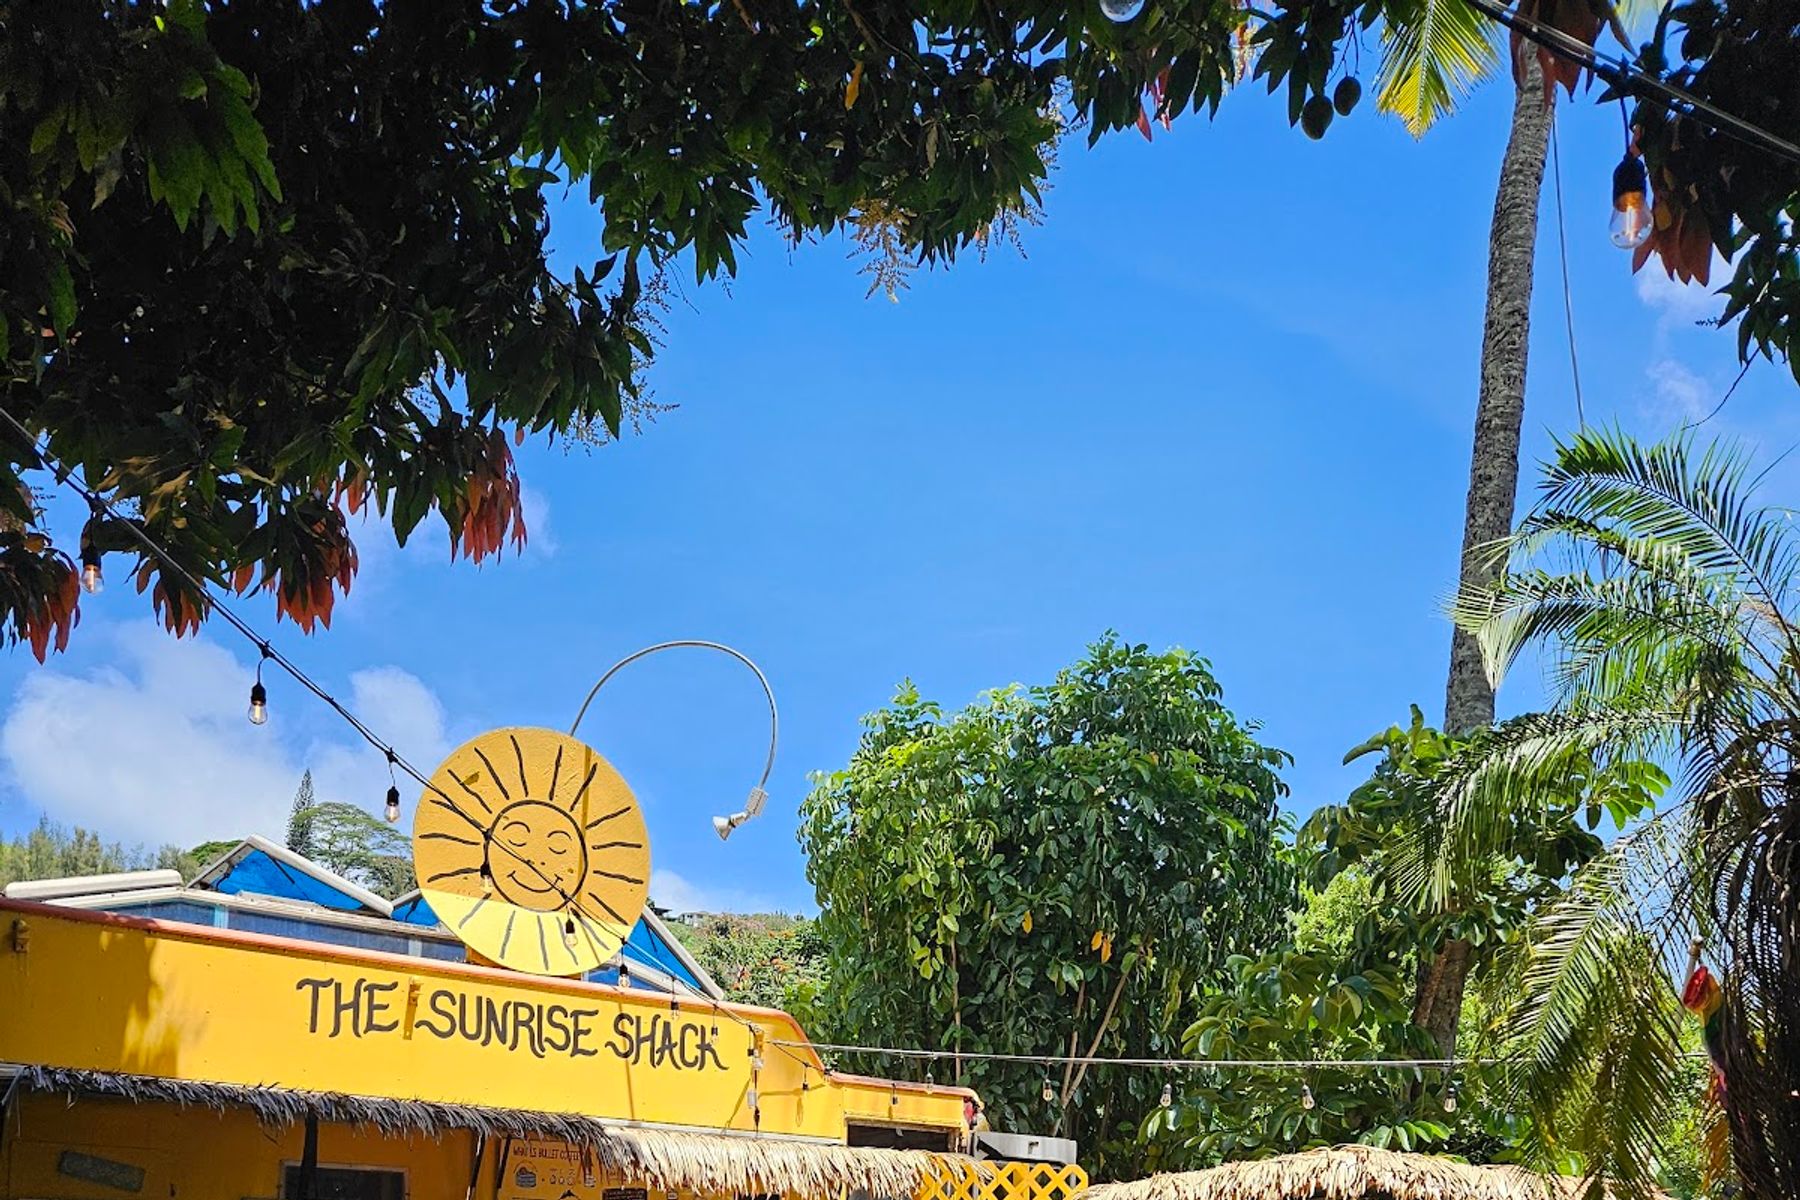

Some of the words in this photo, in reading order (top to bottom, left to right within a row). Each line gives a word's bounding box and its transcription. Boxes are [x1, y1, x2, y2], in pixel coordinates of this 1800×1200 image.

[296, 977, 399, 1038] THE
[415, 990, 599, 1058] SUNRISE
[605, 1012, 729, 1071] SHACK
